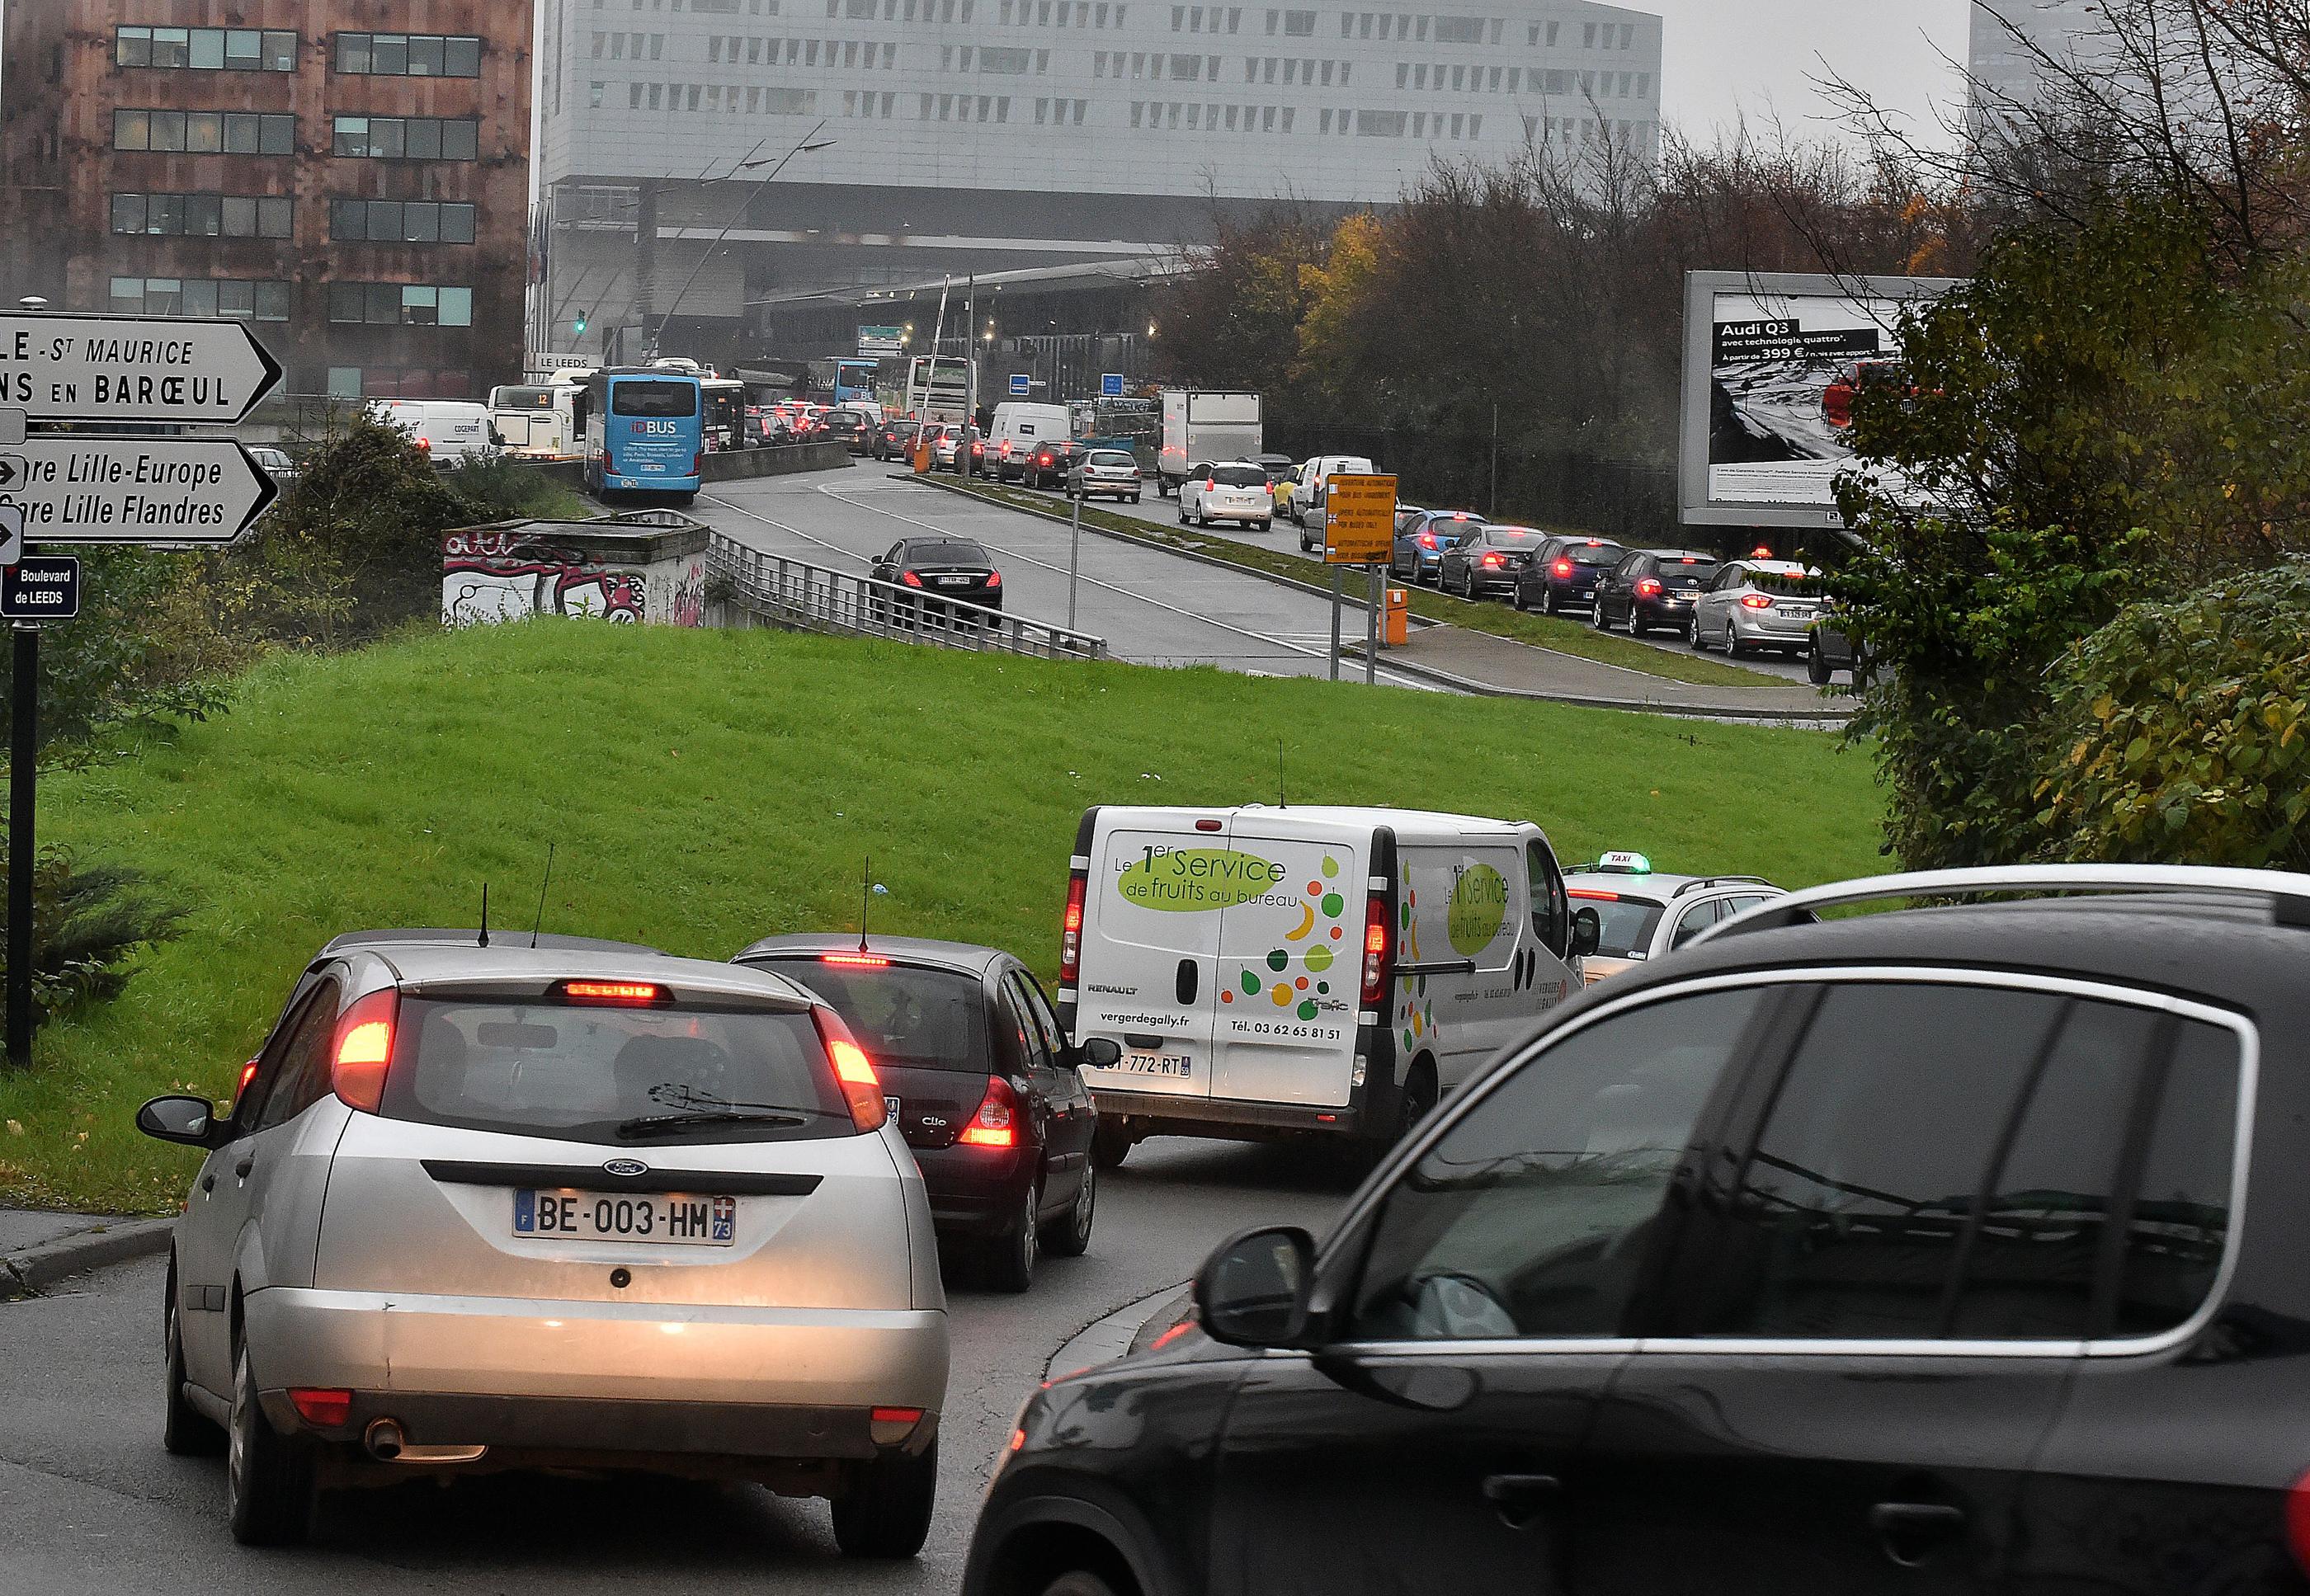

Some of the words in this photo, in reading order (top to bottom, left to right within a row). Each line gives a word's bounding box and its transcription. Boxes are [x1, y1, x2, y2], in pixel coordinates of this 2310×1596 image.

[1721, 323, 1761, 337] Audi
[1766, 322, 1789, 335] Q3
[1745, 337, 1802, 346] technologie
[86, 339, 192, 365] MAURICE
[1729, 354, 1749, 362] partir
[1761, 348, 1790, 360] 399
[1794, 347, 1804, 358] €
[541, 358, 552, 367] LE
[556, 358, 587, 368] LEEDS
[51, 384, 76, 403] EN
[538, 394, 547, 404] 12
[631, 421, 676, 435] iDBUS
[67, 454, 222, 492] Lille-Europe
[63, 494, 112, 524] Lille
[121, 496, 224, 525] Flandres
[21, 569, 70, 582] Boulevard
[15, 591, 27, 604] de
[30, 591, 63, 604] LEEDS
[1611, 854, 1631, 863] TAXI
[1115, 858, 1132, 872] Le
[1172, 850, 1286, 883] Service
[1126, 883, 1148, 897] de
[1152, 878, 1204, 901] fruits
[1209, 890, 1231, 902] au
[1238, 890, 1298, 907] bureau
[1464, 869, 1509, 905] Service
[1088, 984, 1138, 995] RENAULT
[1101, 1013, 1190, 1028] vergerdegally.fr
[1232, 1021, 1250, 1032] Tél.
[1255, 1023, 1270, 1033] 03
[1274, 1024, 1289, 1035] 62
[1293, 1026, 1308, 1037] 65
[1311, 1028, 1323, 1038] 81
[1327, 1029, 1341, 1040] 51
[1107, 1055, 1179, 1075] T-772-RT
[922, 1116, 947, 1126] Clio
[614, 1161, 639, 1173] Ford
[521, 1214, 528, 1225] F
[538, 1195, 708, 1237] BE-003-HM
[714, 1221, 731, 1237] 73
